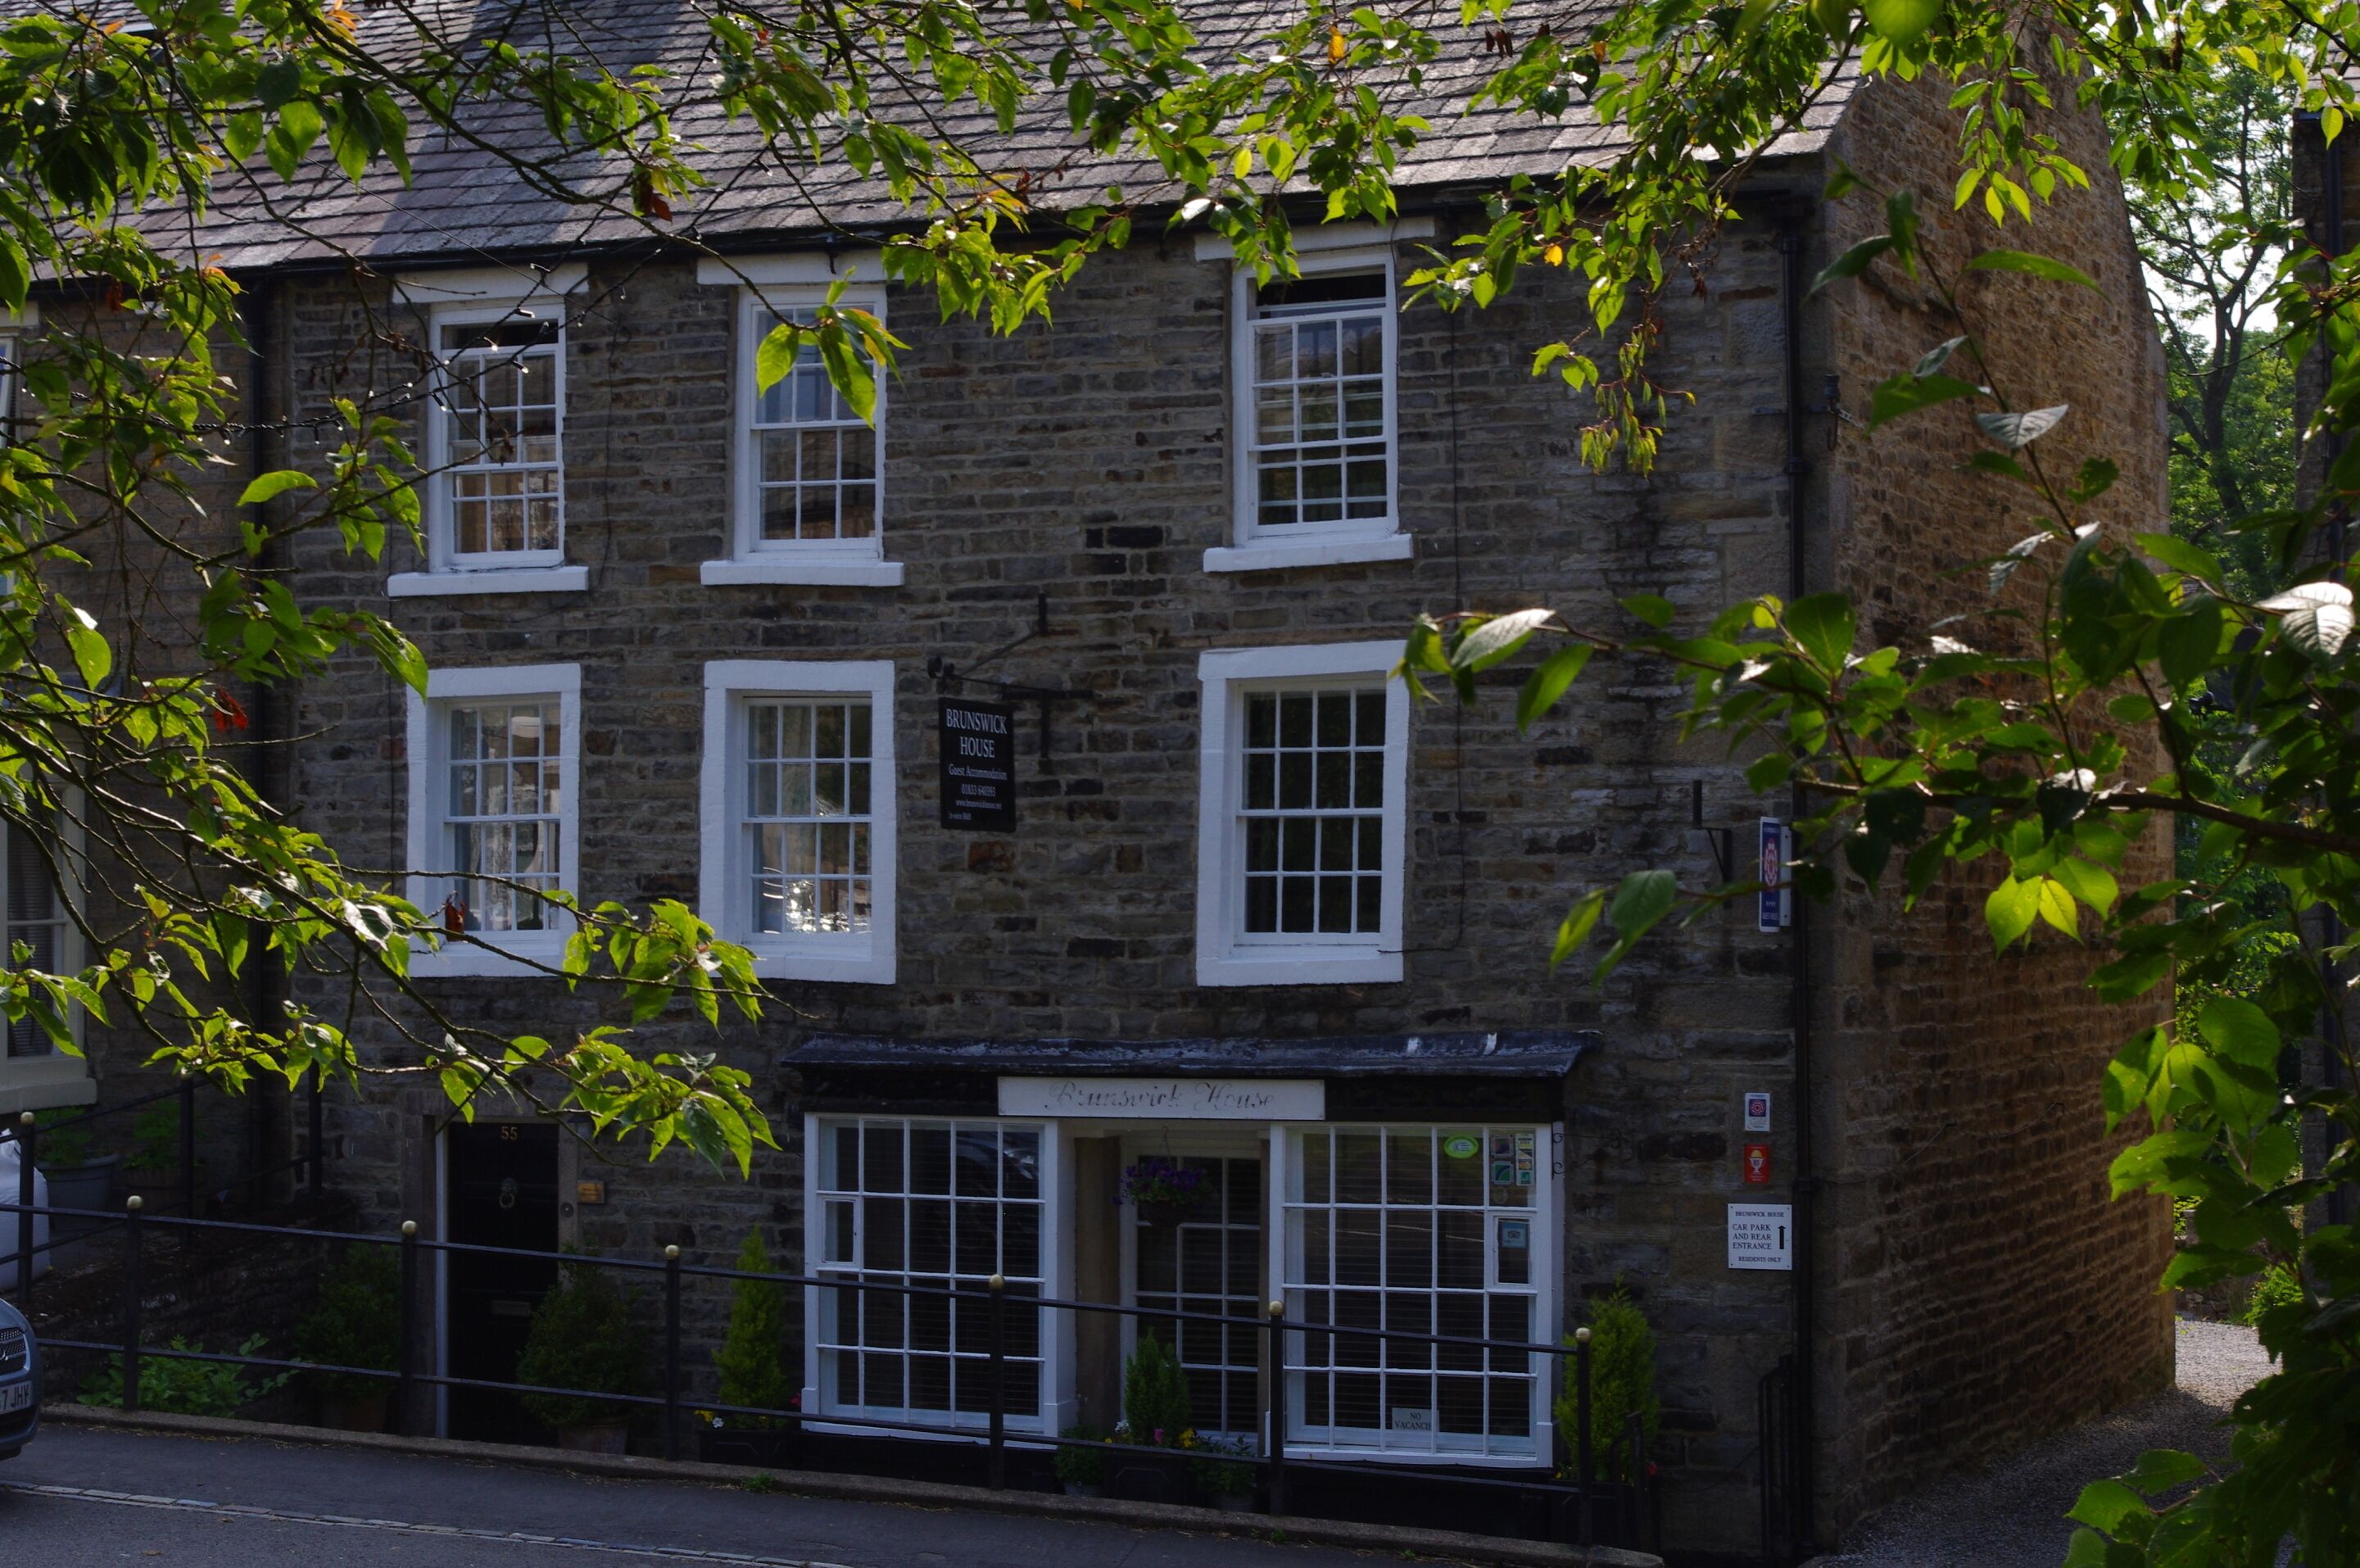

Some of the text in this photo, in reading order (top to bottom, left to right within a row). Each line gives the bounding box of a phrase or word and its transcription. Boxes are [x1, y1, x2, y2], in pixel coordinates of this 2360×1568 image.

[946, 708, 1008, 734] BRUNSWICK
[960, 736, 995, 759] HOUSE
[949, 764, 1008, 781] Guest Accommodation
[1044, 1080, 1275, 1111] Brunswick House
[501, 1126, 519, 1140] 55
[0, 1384, 29, 1410] 7 JHY
[1394, 1421, 1432, 1430] VACANCIE
